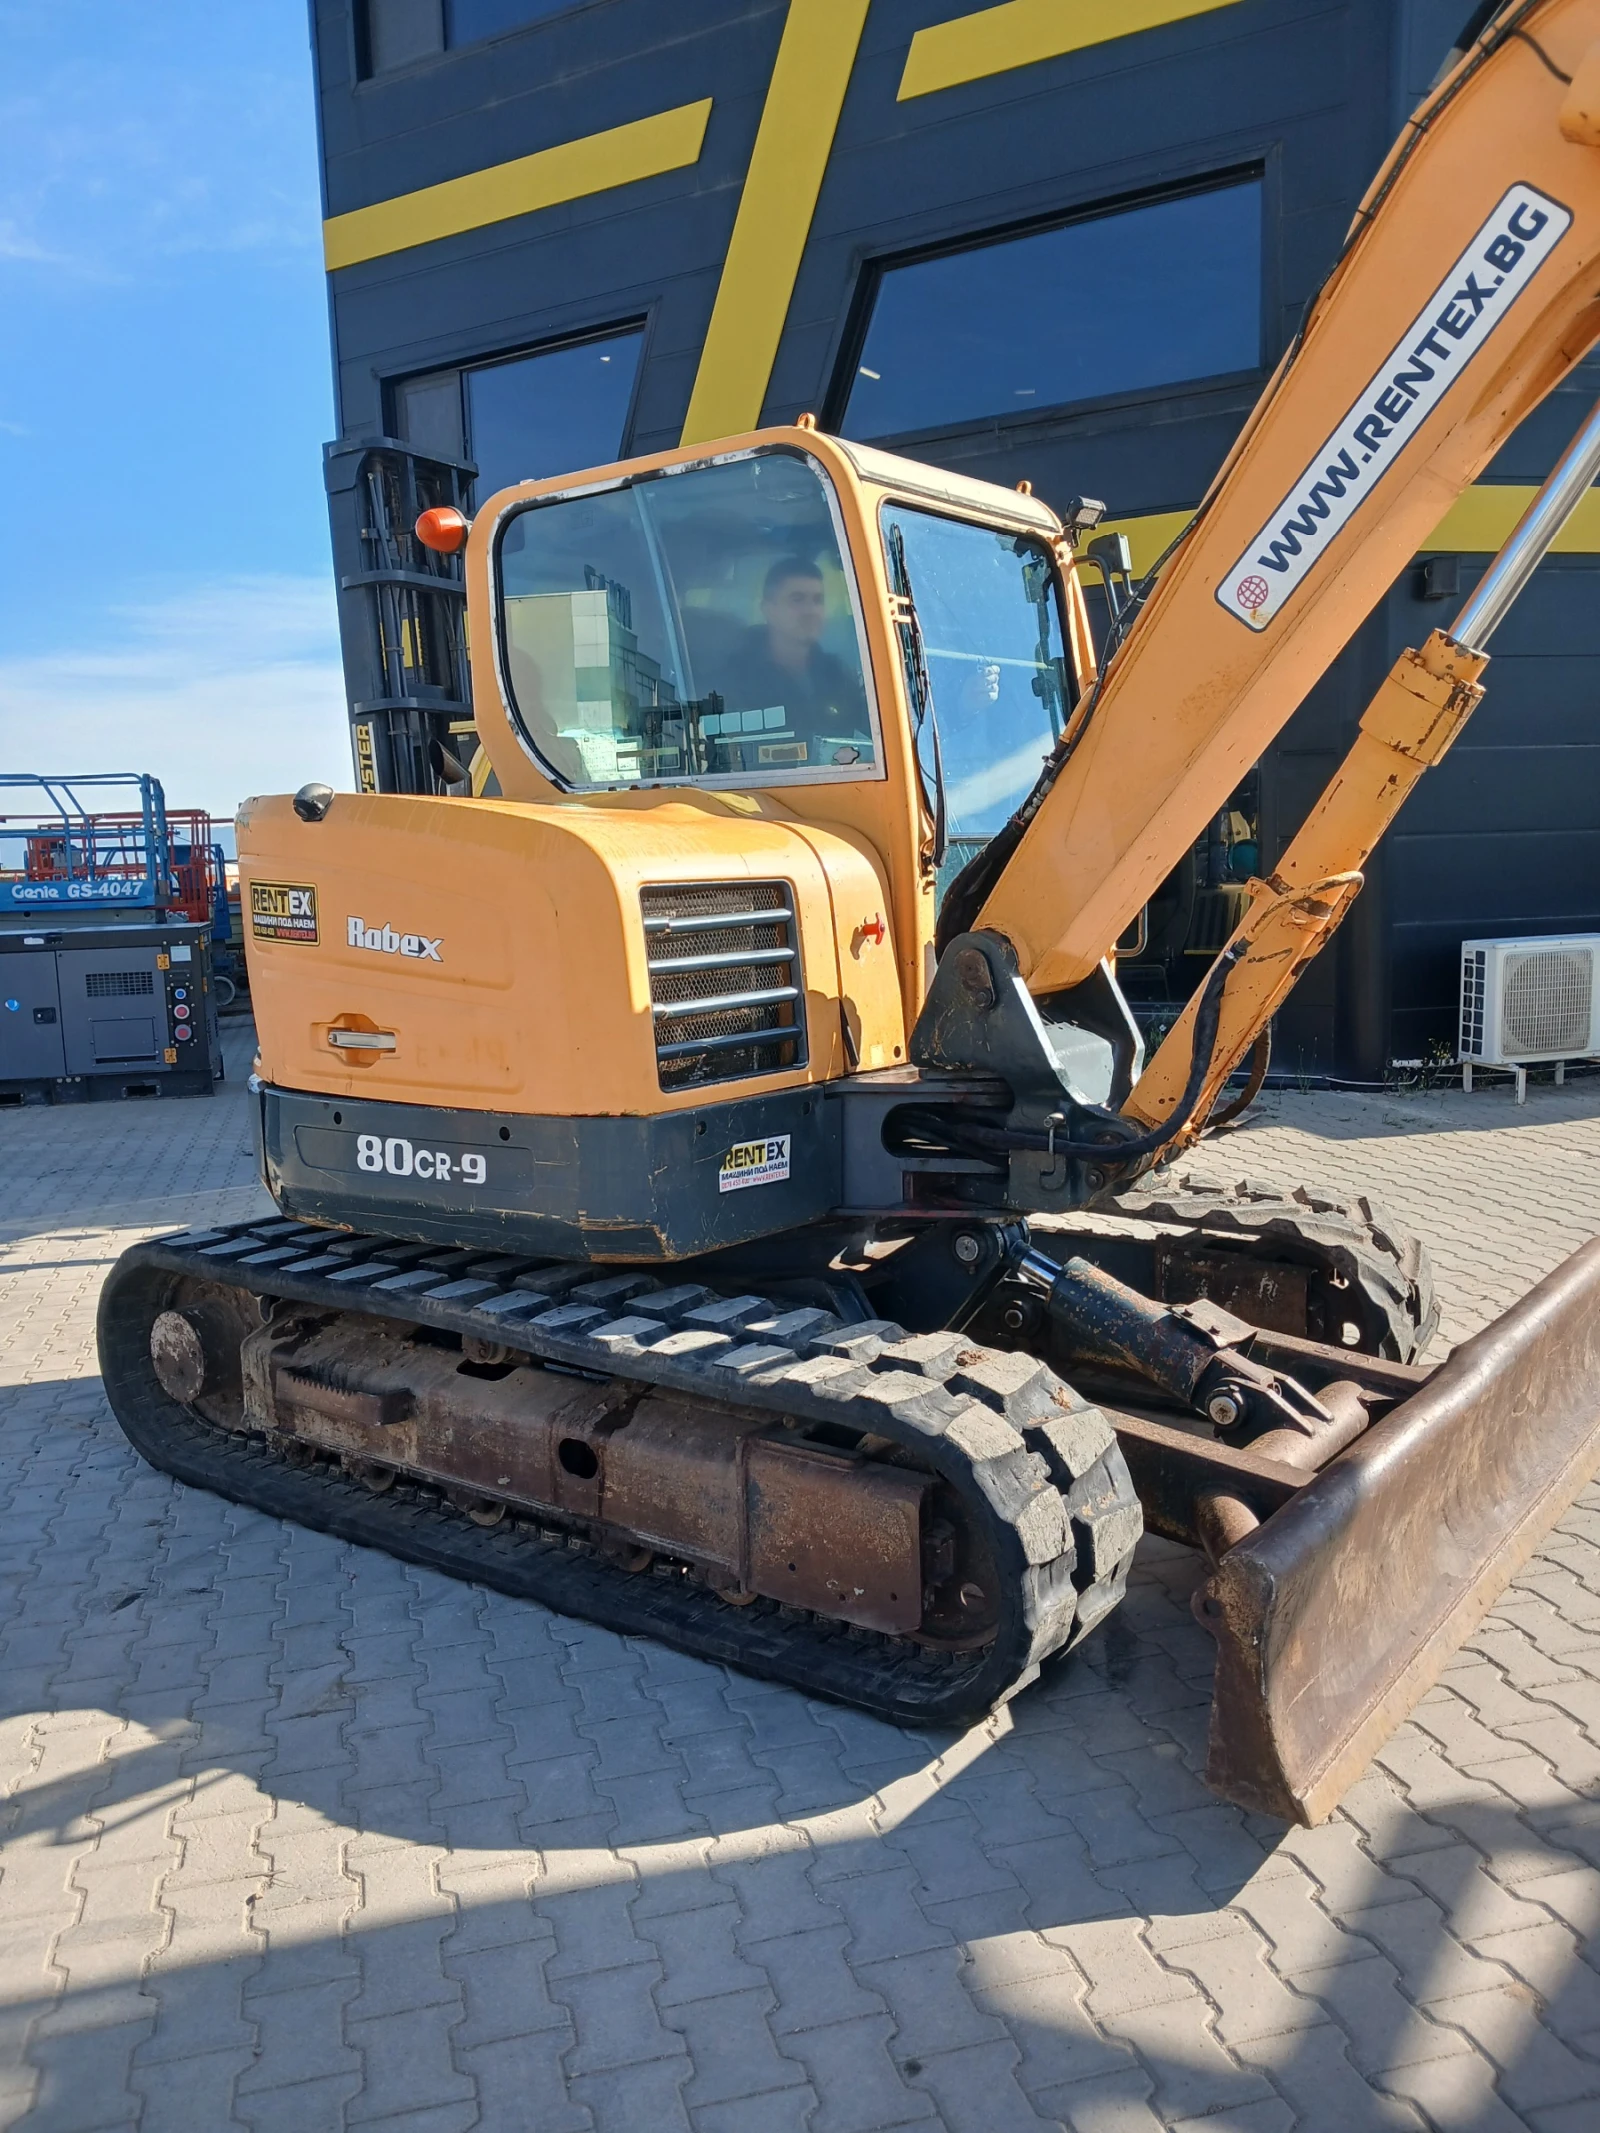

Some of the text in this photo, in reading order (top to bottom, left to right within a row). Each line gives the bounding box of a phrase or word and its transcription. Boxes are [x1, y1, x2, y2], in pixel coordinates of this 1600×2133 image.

[1257, 202, 1549, 573] WWW.RENTEX.BG
[357, 725, 375, 793] YSTER
[12, 881, 143, 899] Genie GS-4047
[252, 888, 313, 916] RENTEX
[278, 917, 292, 927] ПОД
[293, 918, 315, 929] НАЕМ
[347, 915, 444, 962] Robex
[356, 1134, 487, 1184] 80CR-9
[723, 1140, 786, 1170] RENTEX
[754, 1164, 768, 1175] ПОД
[768, 1161, 788, 1172] НАЕМ
